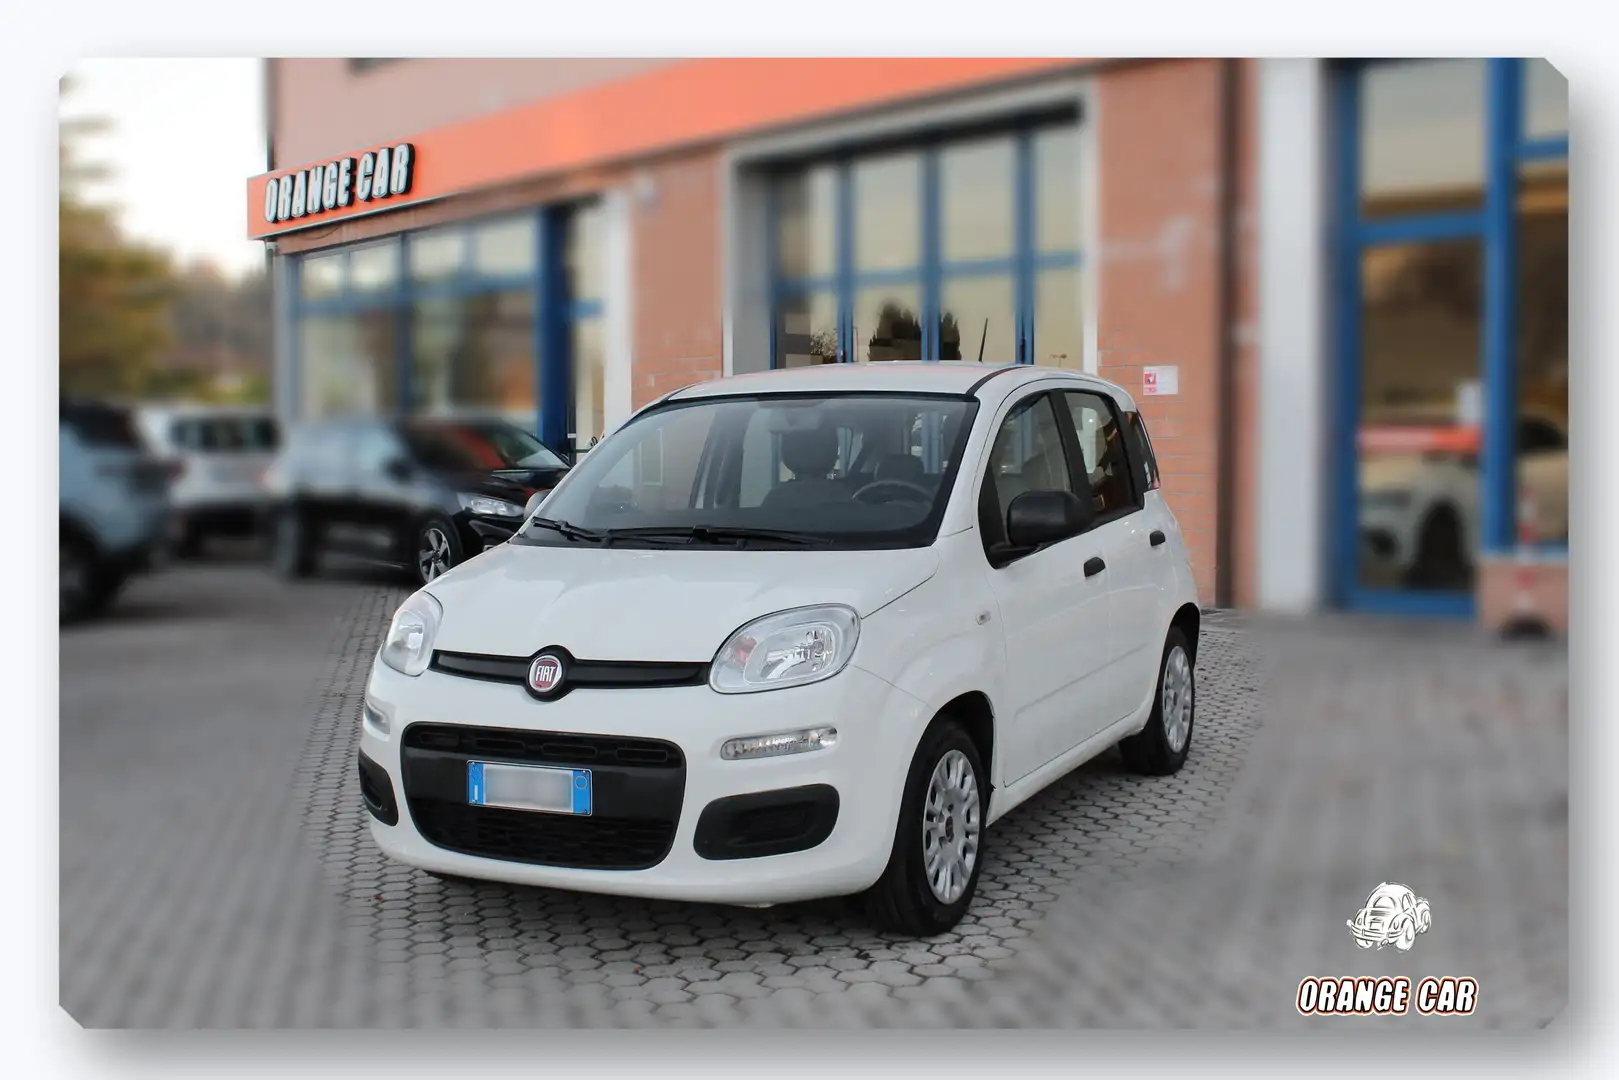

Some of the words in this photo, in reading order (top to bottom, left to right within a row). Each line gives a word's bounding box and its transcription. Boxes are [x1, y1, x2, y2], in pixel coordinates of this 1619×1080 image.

[265, 157, 353, 223] ORANGE
[356, 143, 413, 202] CAR
[535, 665, 556, 682] FIAT
